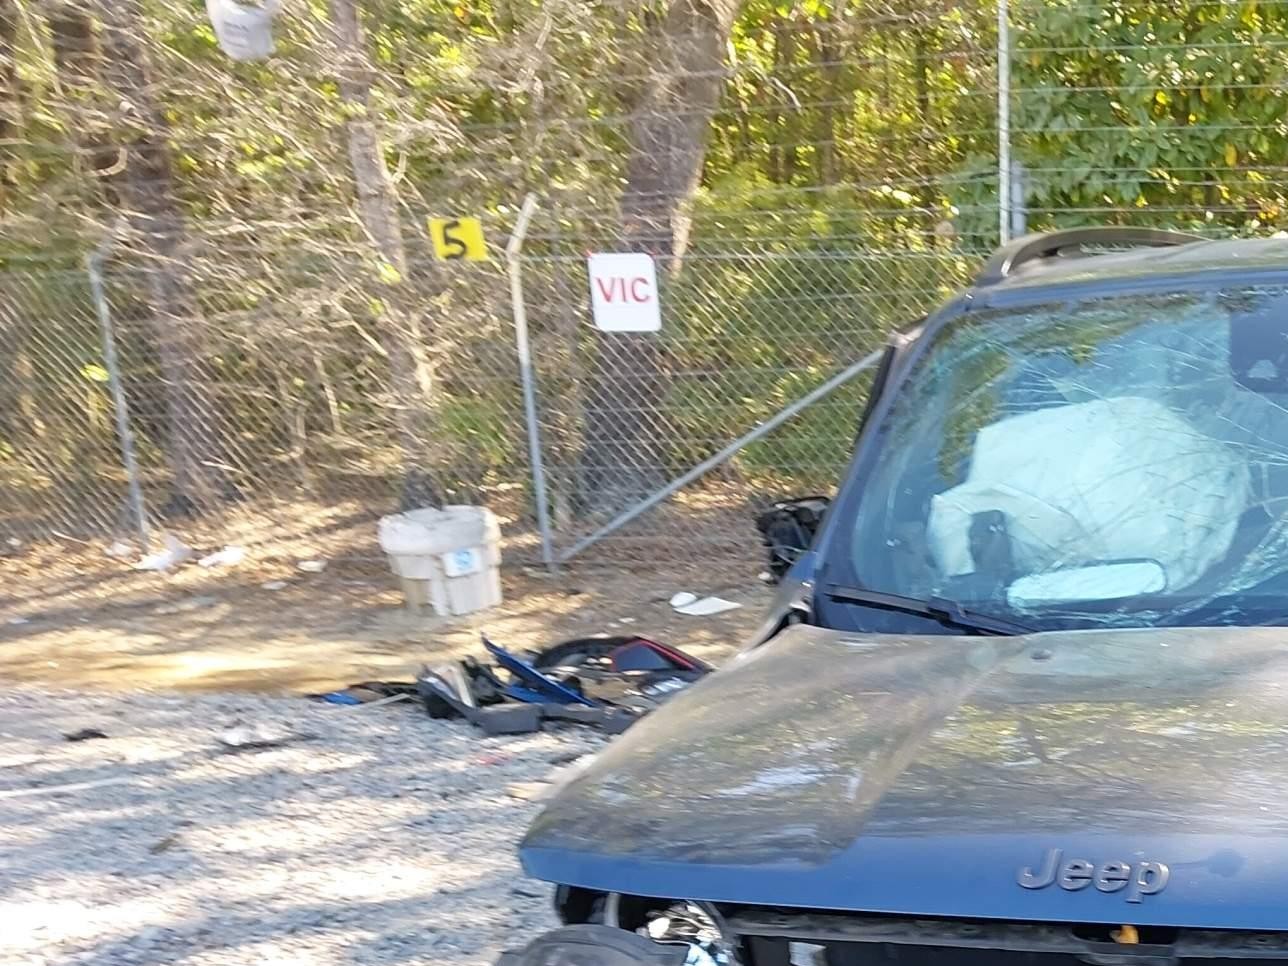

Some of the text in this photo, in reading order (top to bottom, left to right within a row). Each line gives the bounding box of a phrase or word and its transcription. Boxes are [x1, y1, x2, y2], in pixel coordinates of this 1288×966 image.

[441, 220, 468, 260] 5
[595, 276, 651, 304] VIC
[1015, 848, 1170, 904] Jeep
